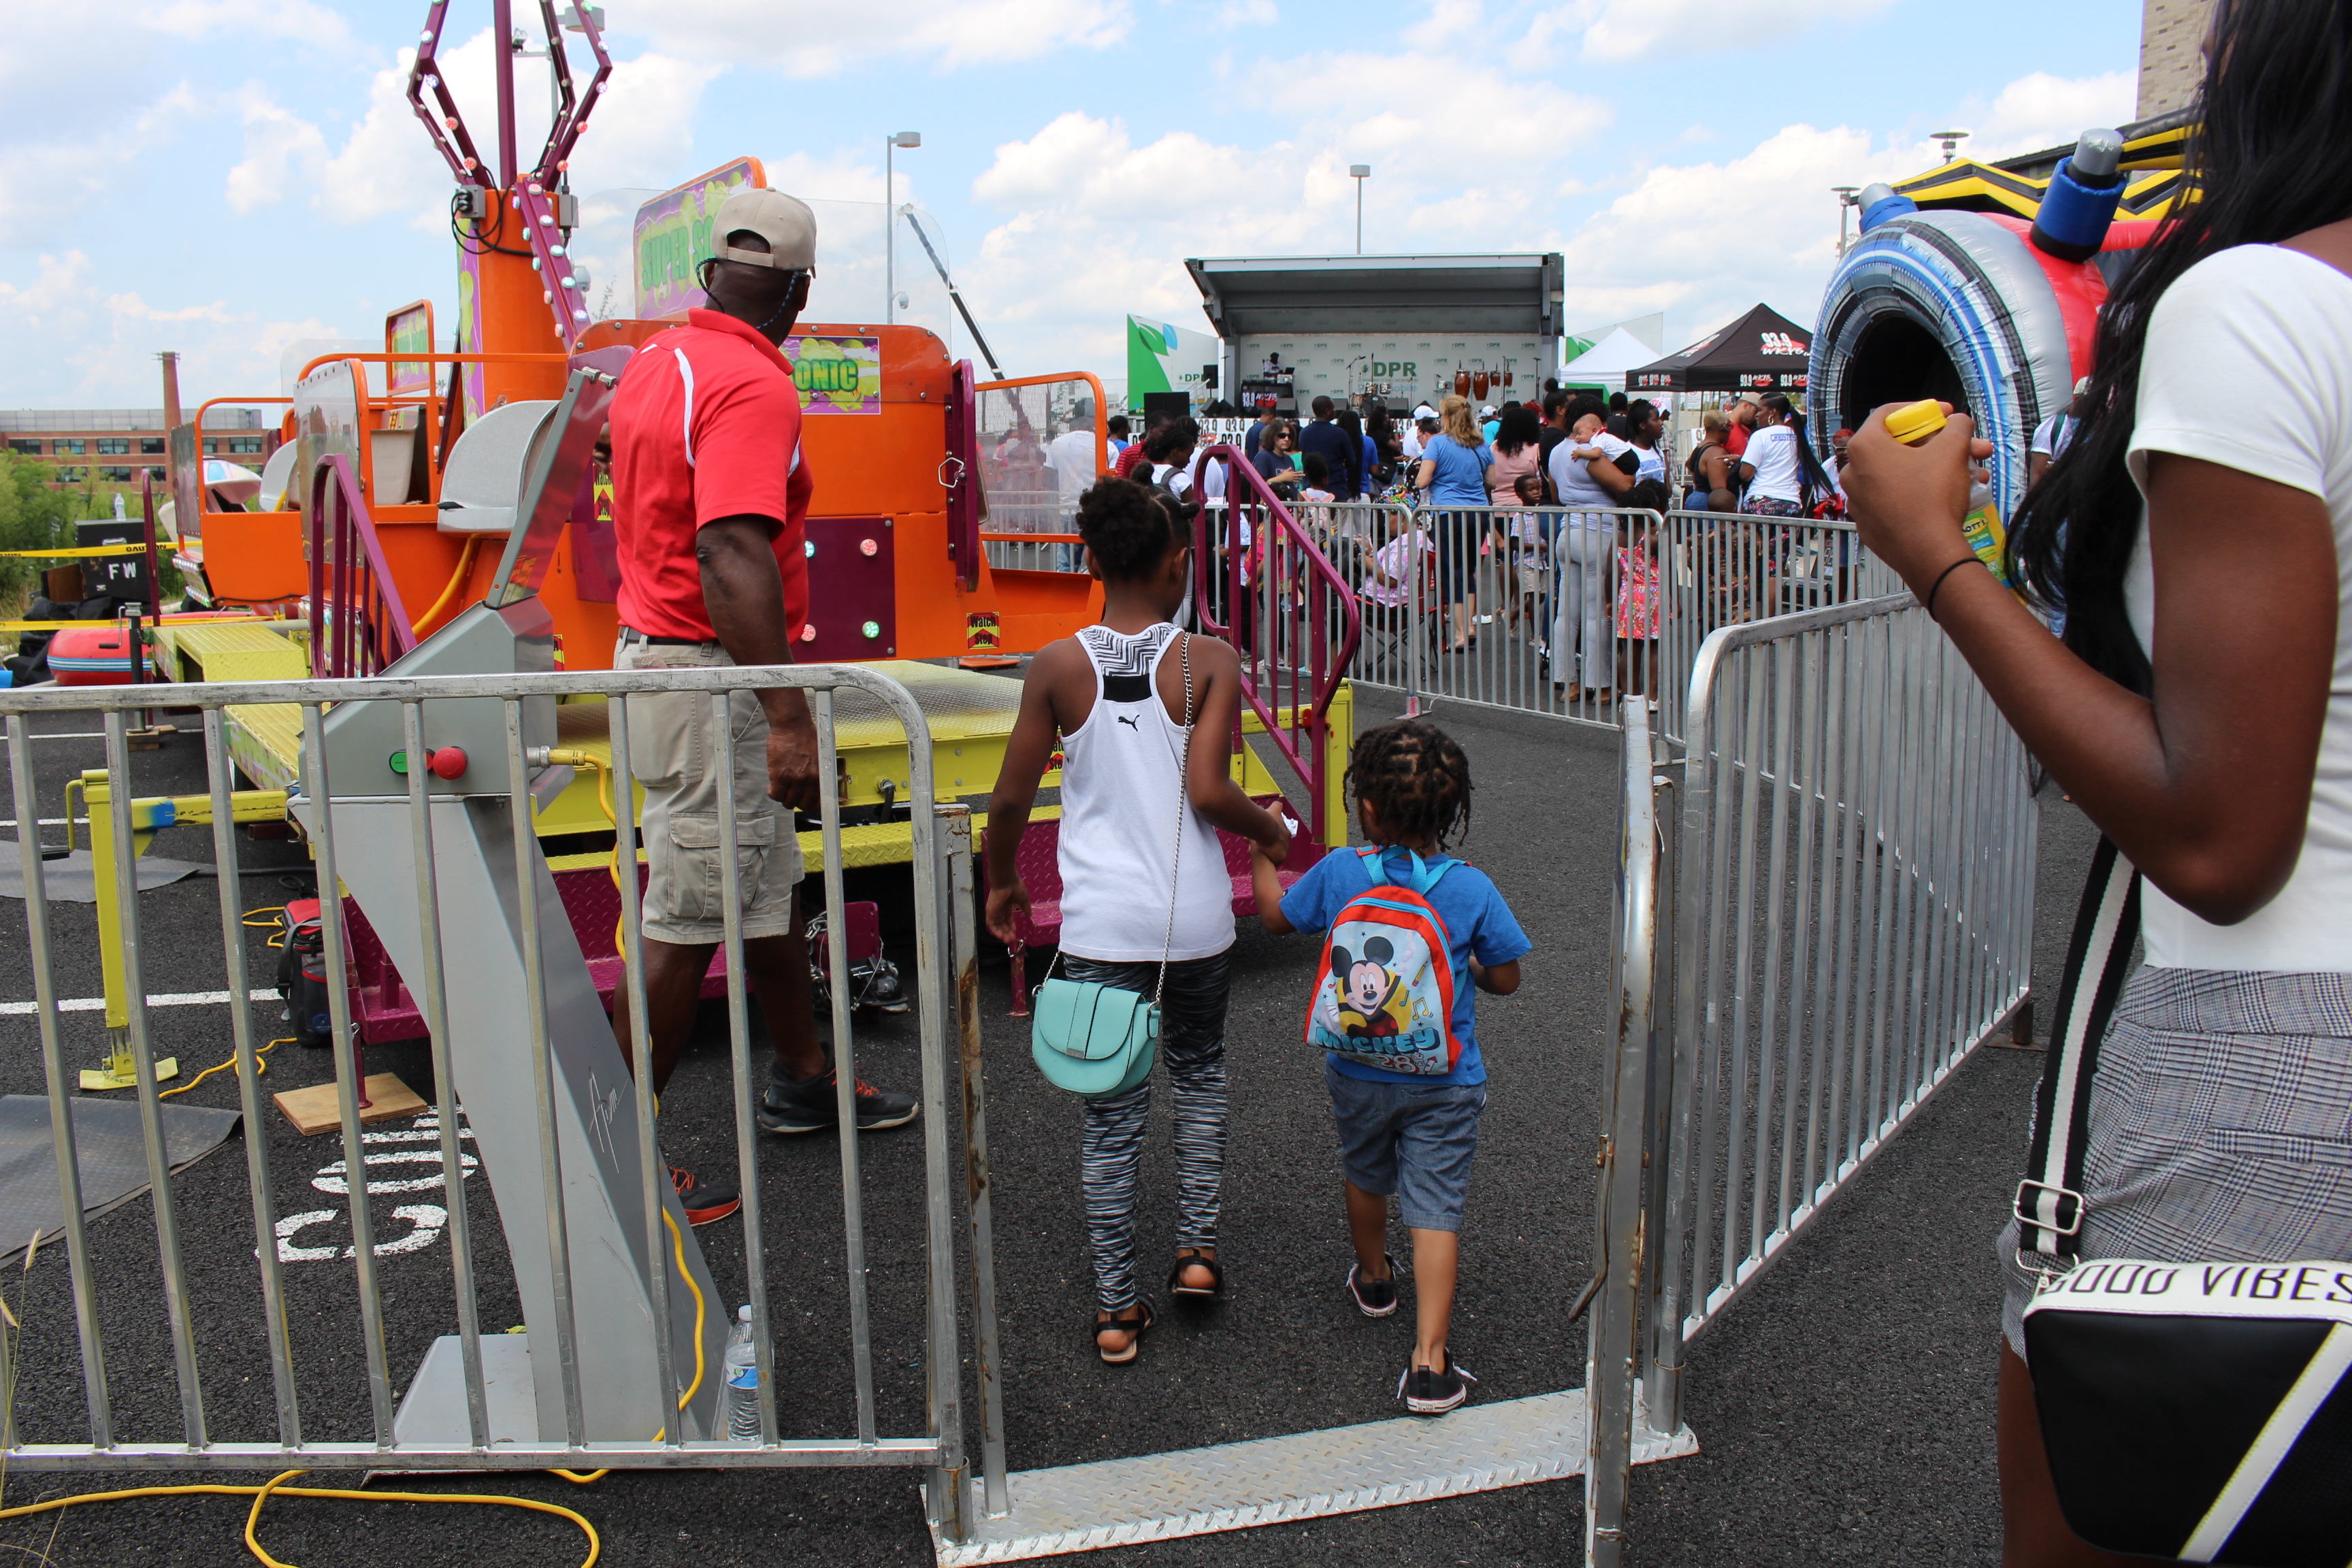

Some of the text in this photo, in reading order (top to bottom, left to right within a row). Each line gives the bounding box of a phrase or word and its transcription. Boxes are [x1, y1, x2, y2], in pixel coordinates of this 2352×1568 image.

[642, 226, 690, 291] SUPER
[1761, 332, 1793, 348] 93.9
[792, 359, 858, 391] ONIC
[1373, 362, 1416, 376] DPR
[1740, 374, 1752, 387] 93.9
[1780, 374, 1793, 387] 93.9
[970, 615, 996, 627] Watch
[975, 632, 992, 645] Step
[1049, 758, 1063, 770] Ste
[1316, 1026, 1440, 1054] MICKEY
[2202, 1265, 2352, 1304] VIBES
